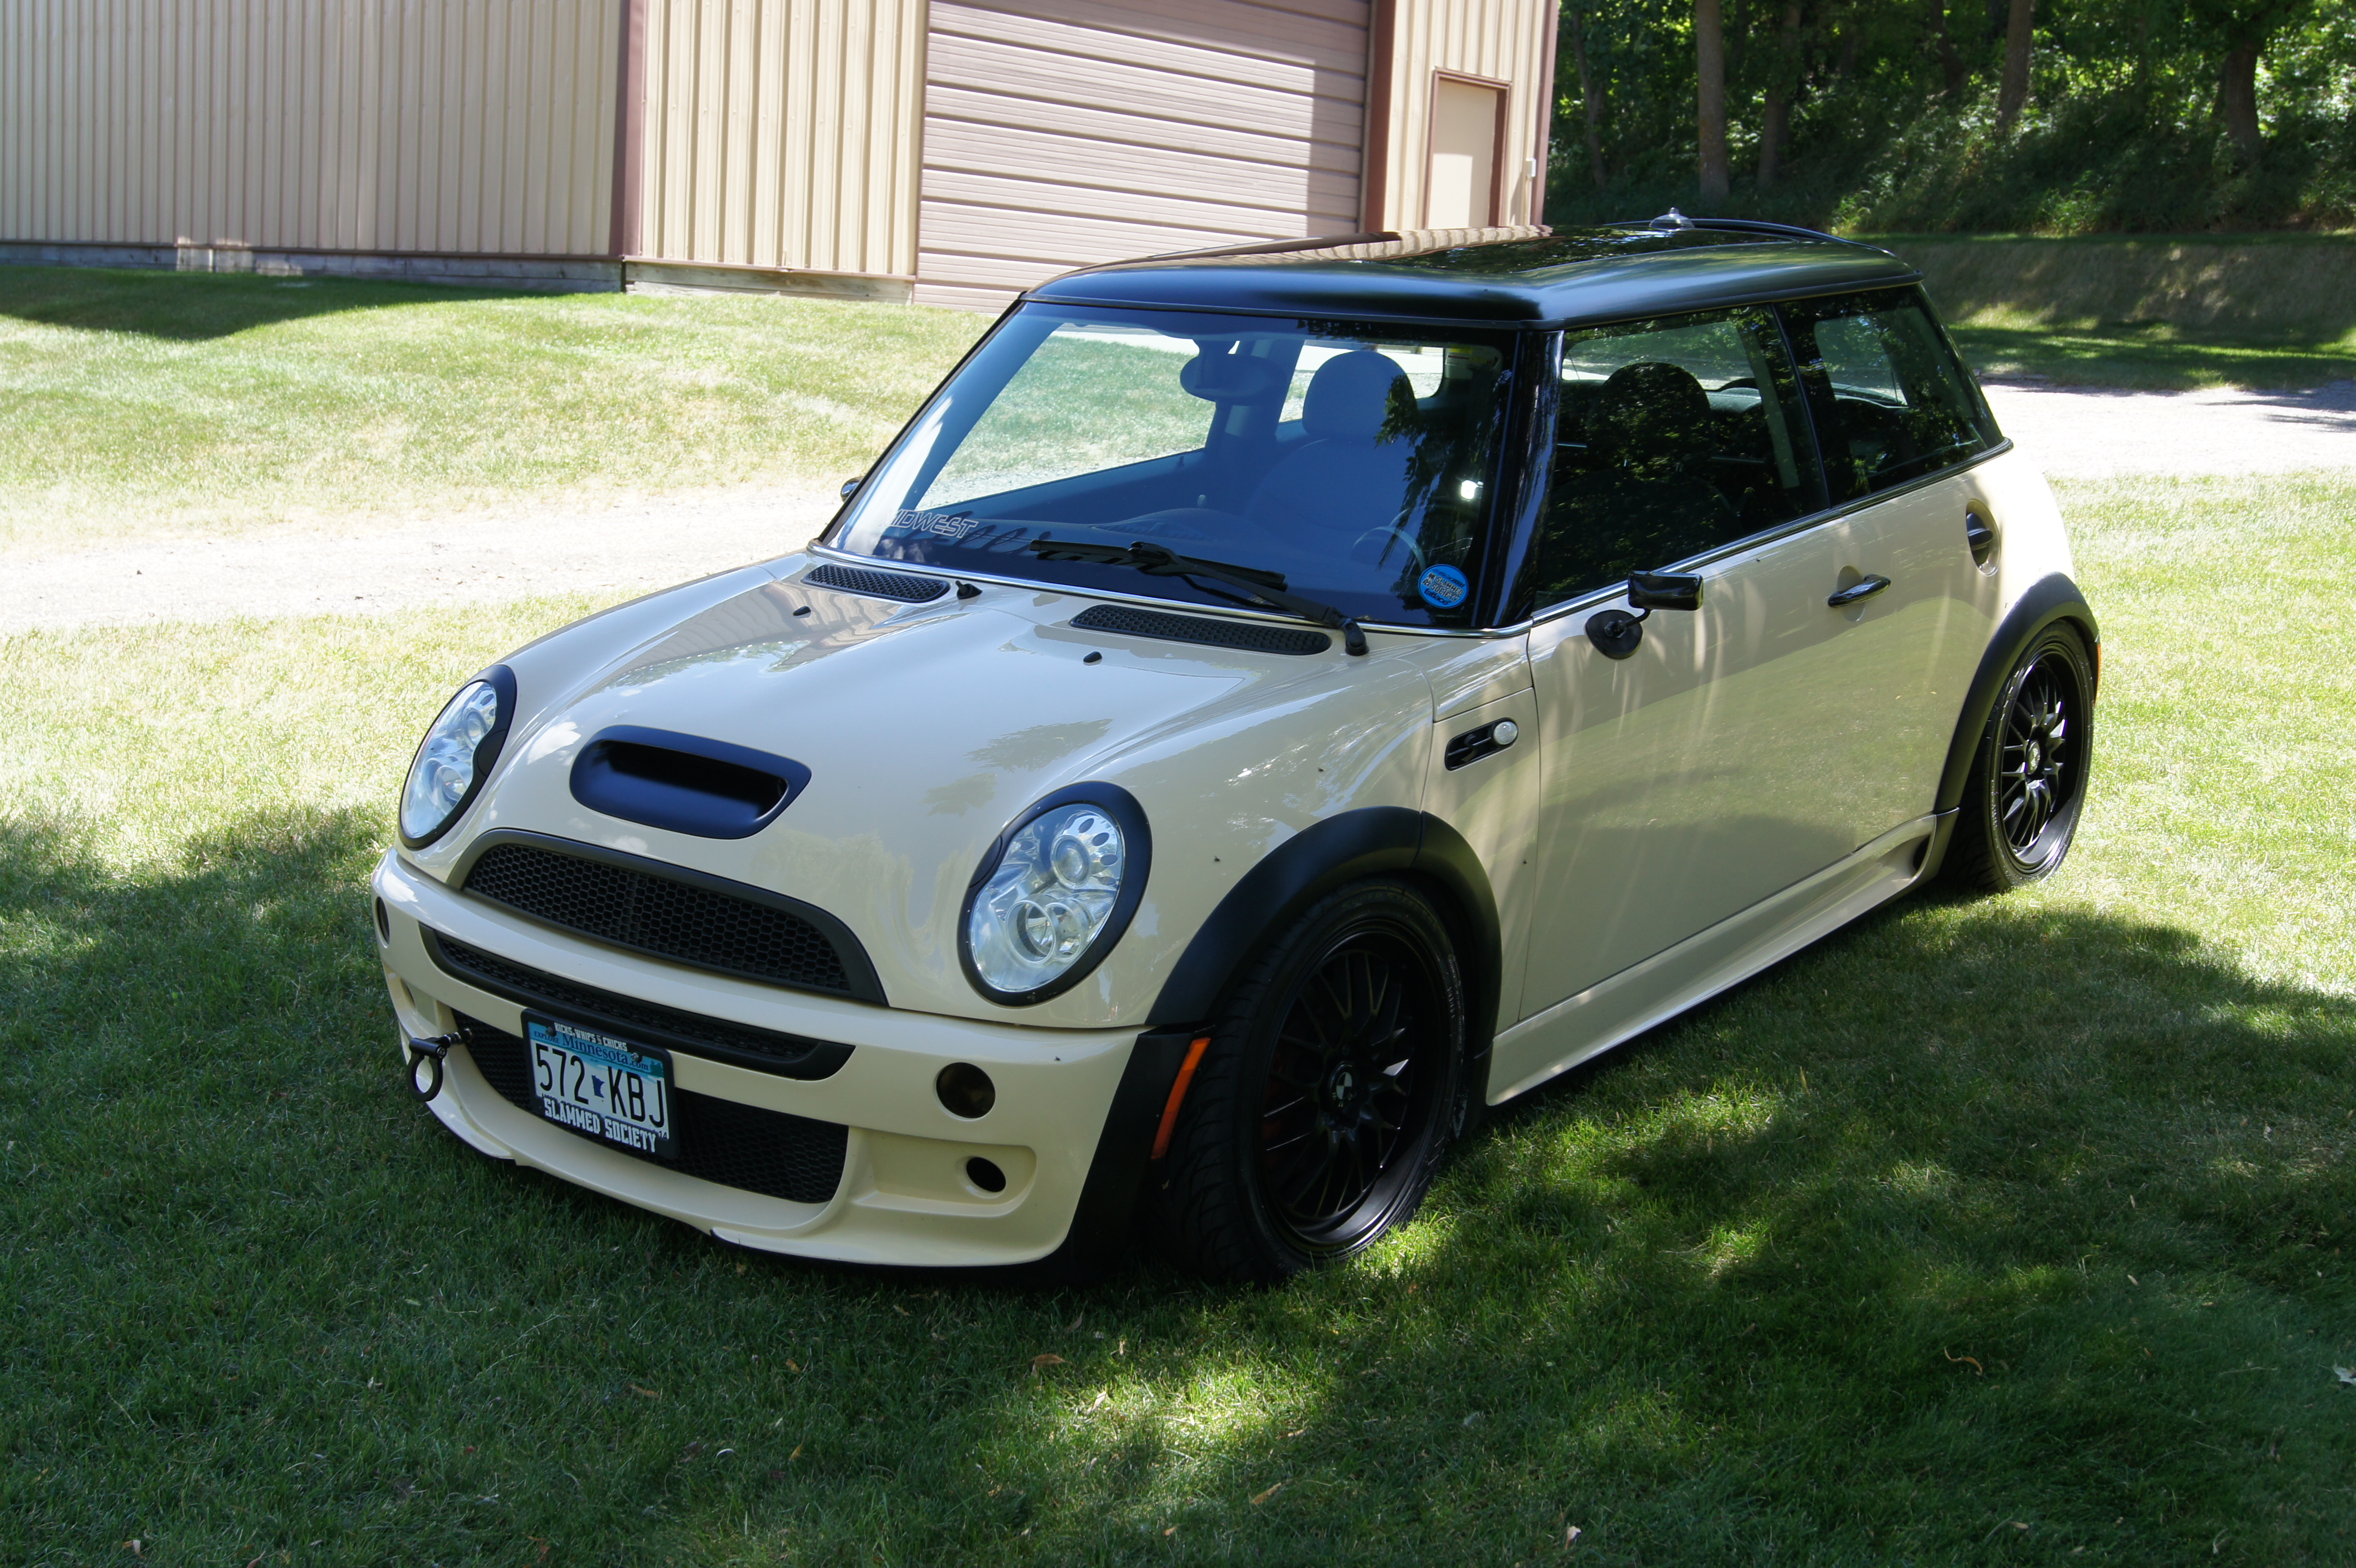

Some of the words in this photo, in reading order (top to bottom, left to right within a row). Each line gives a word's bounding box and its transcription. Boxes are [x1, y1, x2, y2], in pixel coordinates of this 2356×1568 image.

[1432, 582, 1460, 602] SOCIETY
[575, 1029, 596, 1043] WHIPS
[603, 1037, 627, 1051] CHICKS
[536, 1043, 589, 1105] 572
[608, 1066, 664, 1127] KBJ
[544, 1097, 600, 1134] SLAMMED
[605, 1118, 656, 1152] SOCIETY
